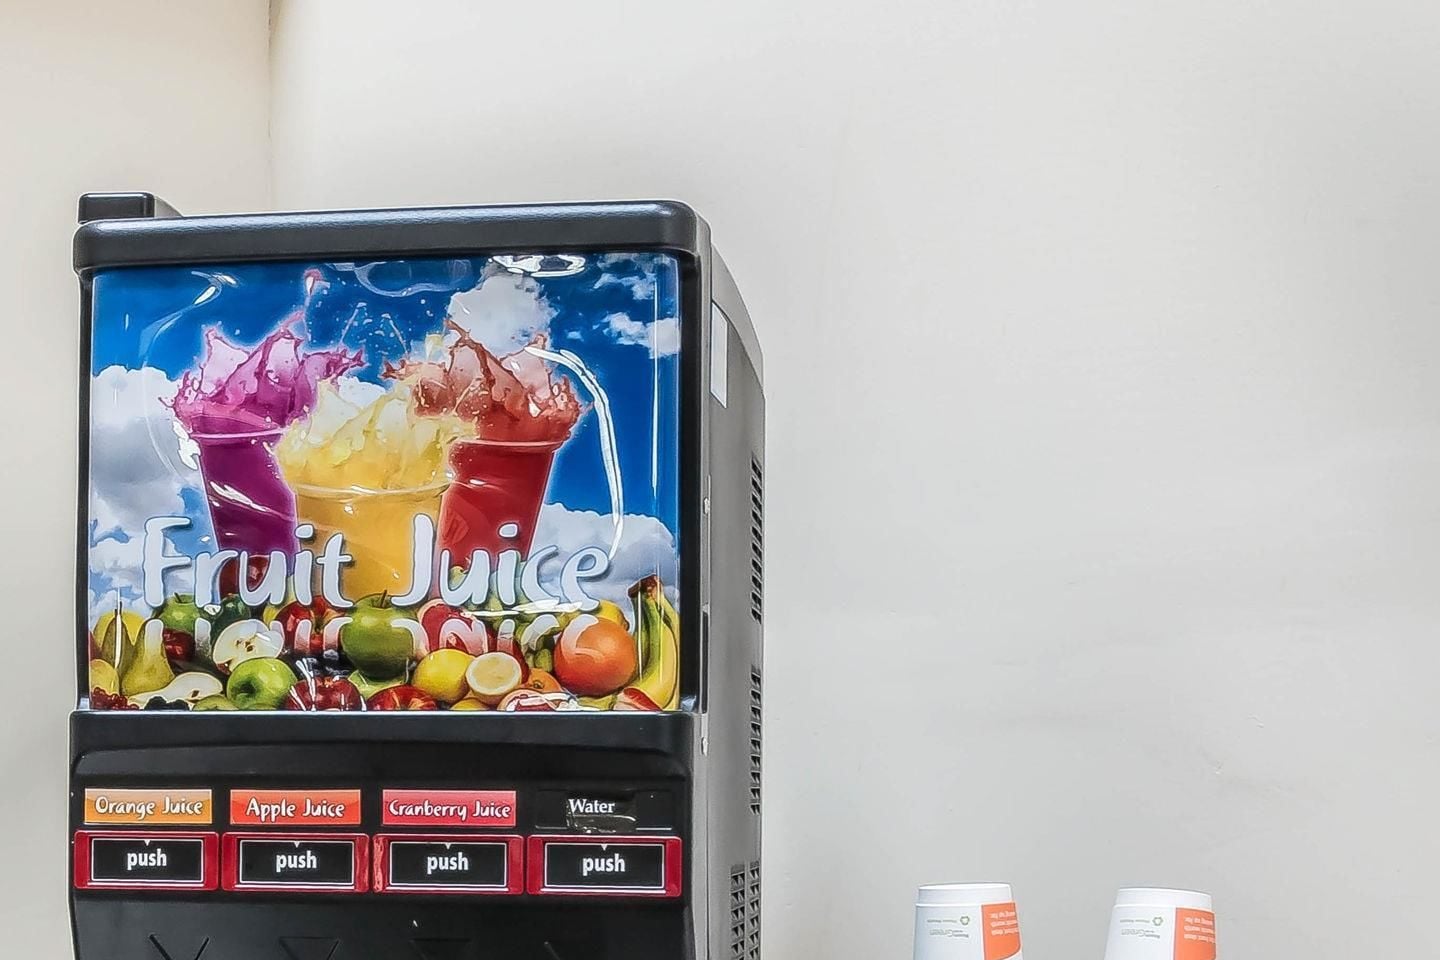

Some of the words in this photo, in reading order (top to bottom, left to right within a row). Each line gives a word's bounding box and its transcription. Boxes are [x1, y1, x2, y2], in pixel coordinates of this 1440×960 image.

[144, 514, 354, 608] Fruit
[390, 512, 610, 611] Juice
[95, 796, 155, 820] Orange
[161, 796, 203, 816] Juice
[245, 797, 296, 823] Apple
[302, 797, 345, 818] Juice
[388, 799, 467, 822] Cranberry
[472, 799, 511, 818] Juice
[569, 798, 616, 814] Water
[126, 848, 167, 871] push
[275, 850, 317, 873] push
[426, 851, 469, 875] push
[582, 852, 626, 877] push
